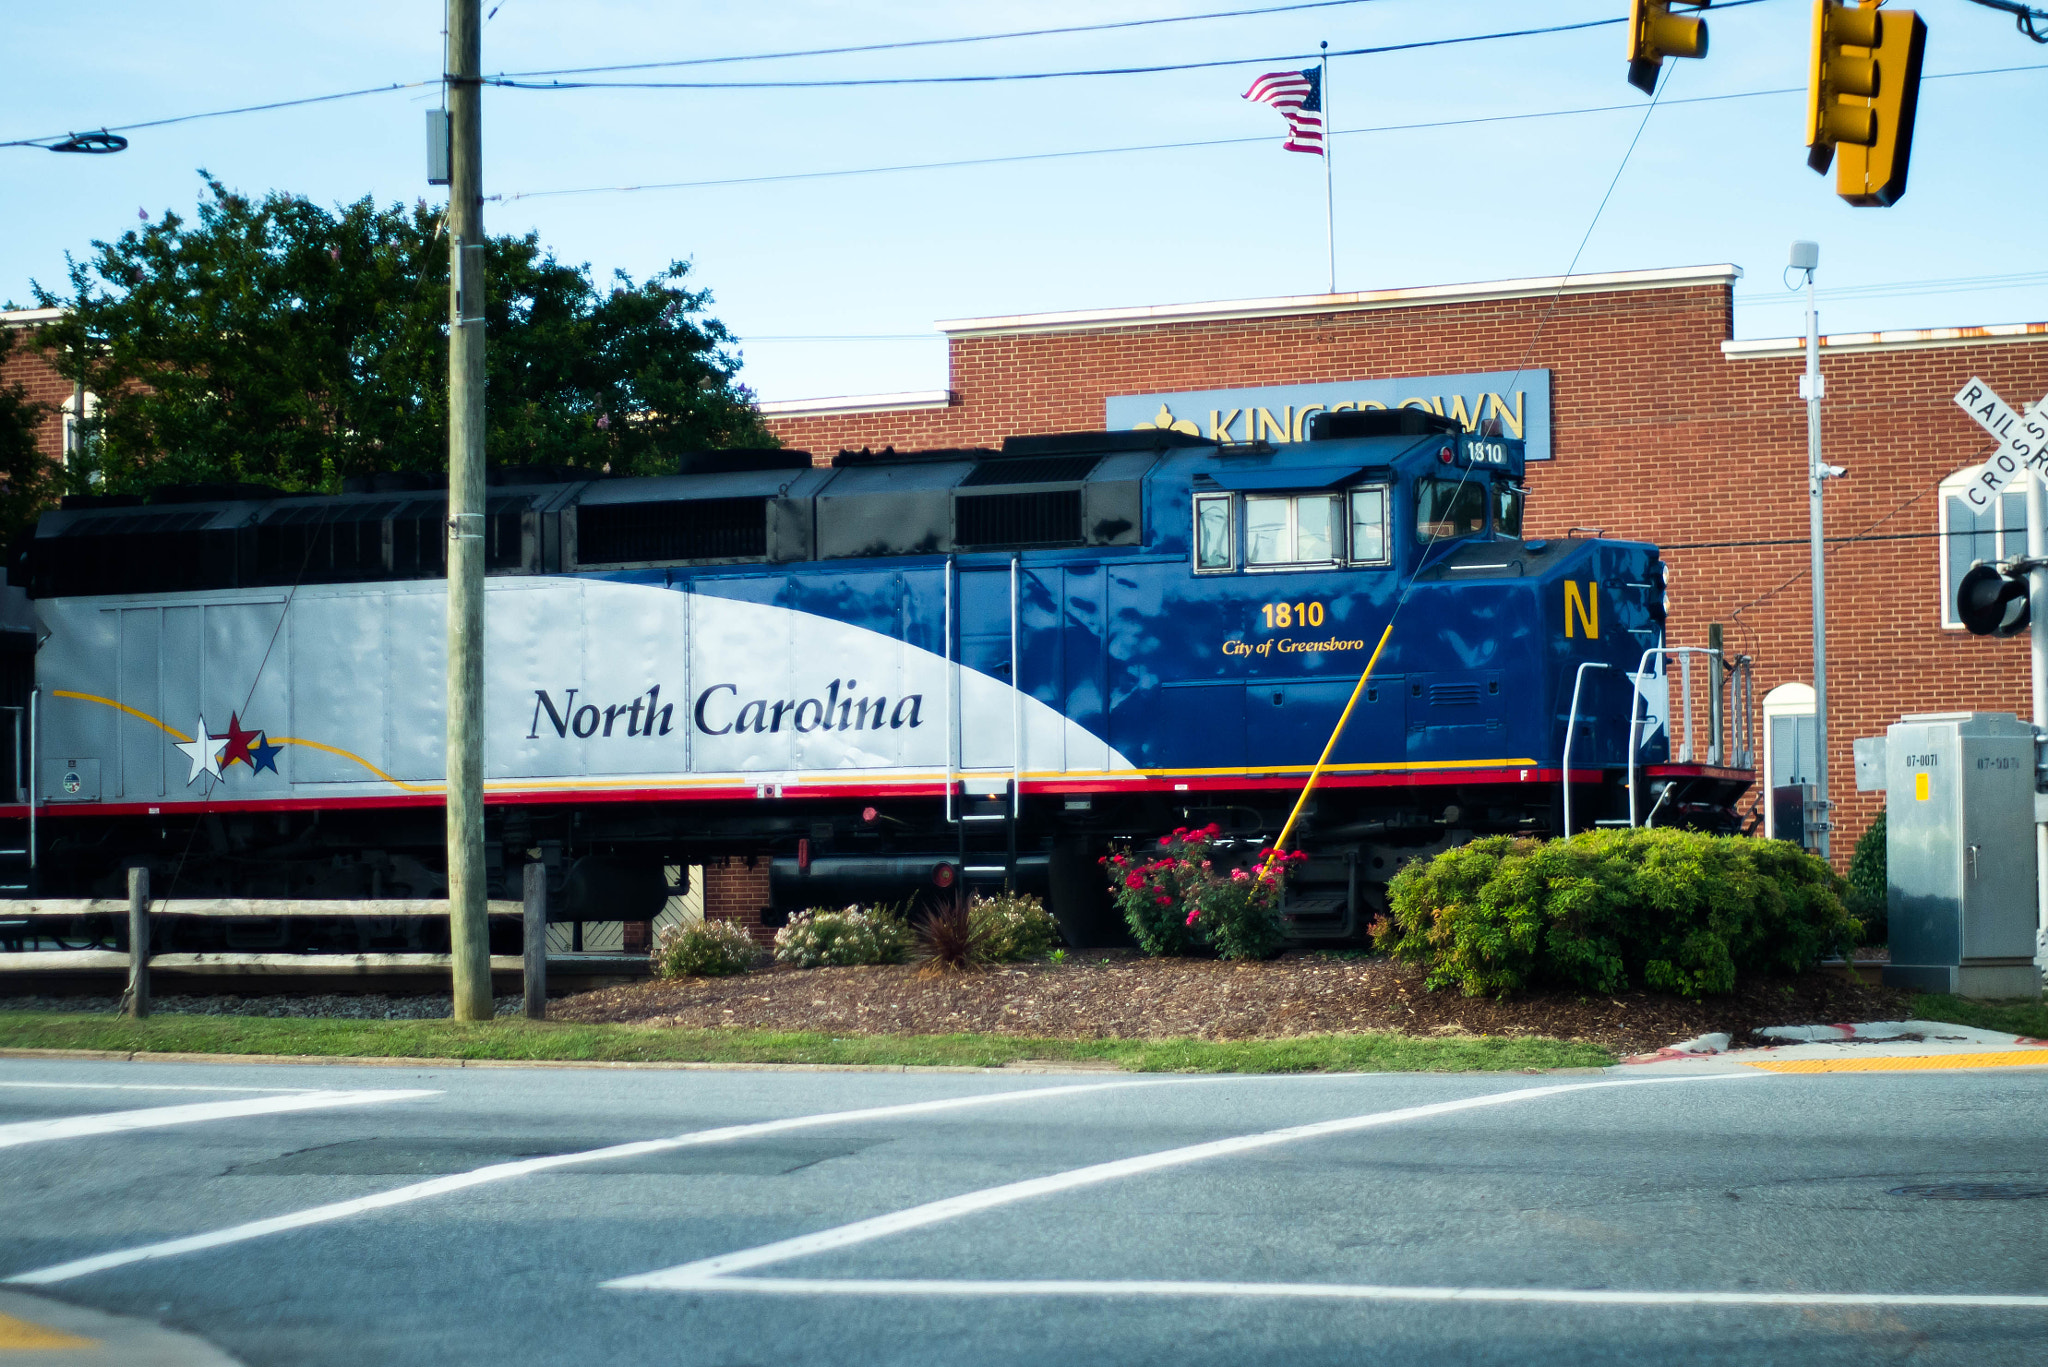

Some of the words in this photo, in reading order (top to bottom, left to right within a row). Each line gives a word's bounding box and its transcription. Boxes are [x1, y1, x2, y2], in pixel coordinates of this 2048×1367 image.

[1962, 385, 2015, 440] RAIL
[1467, 441, 1503, 463] 1810
[1261, 601, 1324, 628] 1810
[1564, 580, 1599, 639] N
[1222, 640, 1254, 658] City
[1256, 638, 1275, 657] of
[1277, 636, 1364, 653] Greensboro
[526, 683, 674, 739] North
[694, 678, 924, 736] Carolina
[1906, 754, 1938, 767] 07-0071
[1520, 769, 1528, 781] F
